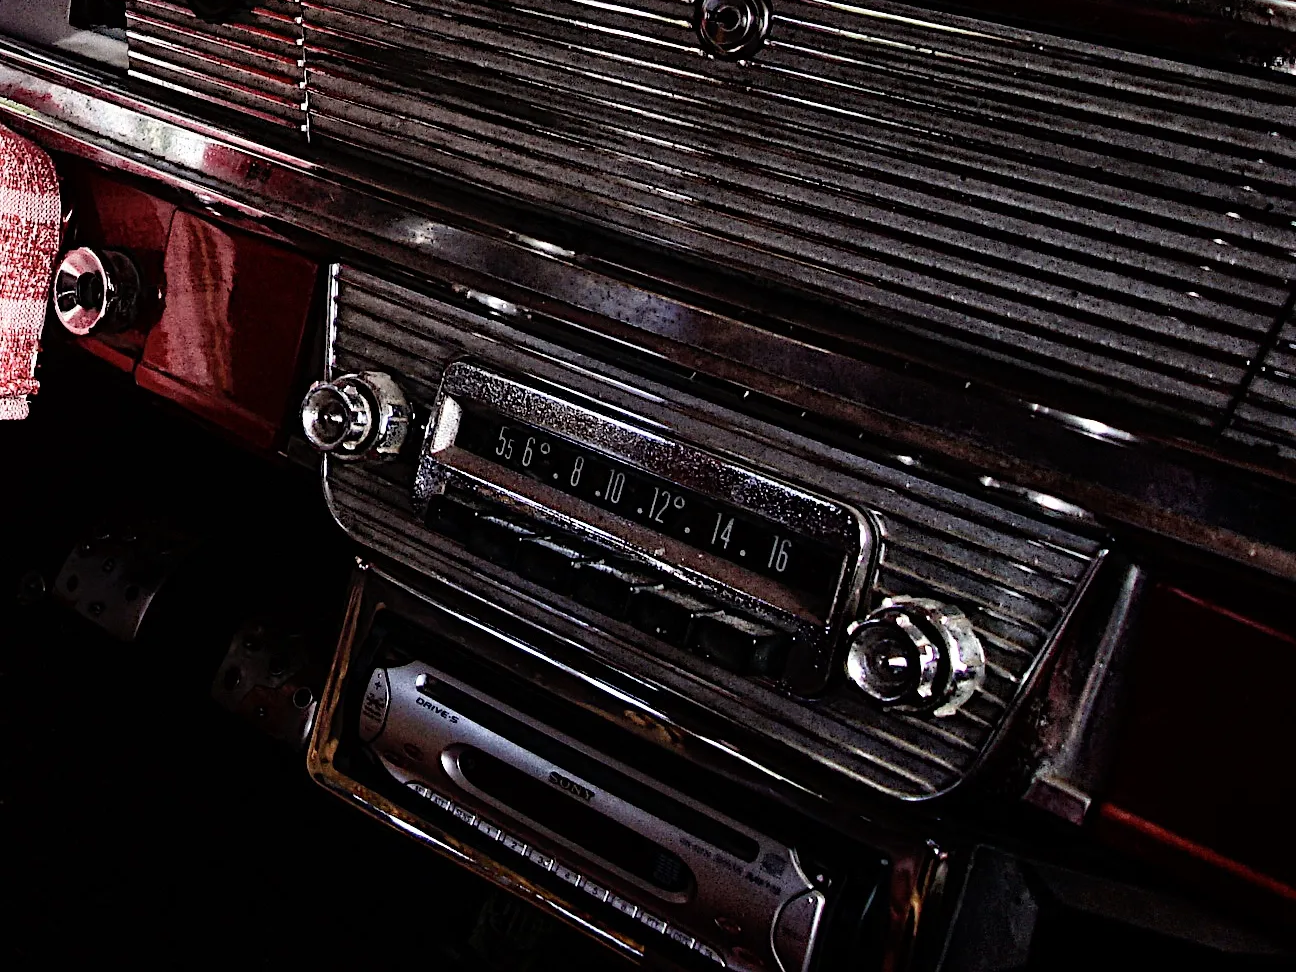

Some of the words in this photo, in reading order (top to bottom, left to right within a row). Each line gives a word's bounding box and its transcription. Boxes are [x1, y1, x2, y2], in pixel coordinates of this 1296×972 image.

[570, 456, 585, 487] 8
[604, 469, 626, 504] 10
[711, 512, 735, 549] 14
[767, 535, 793, 573] 16
[548, 771, 596, 802] SONY
